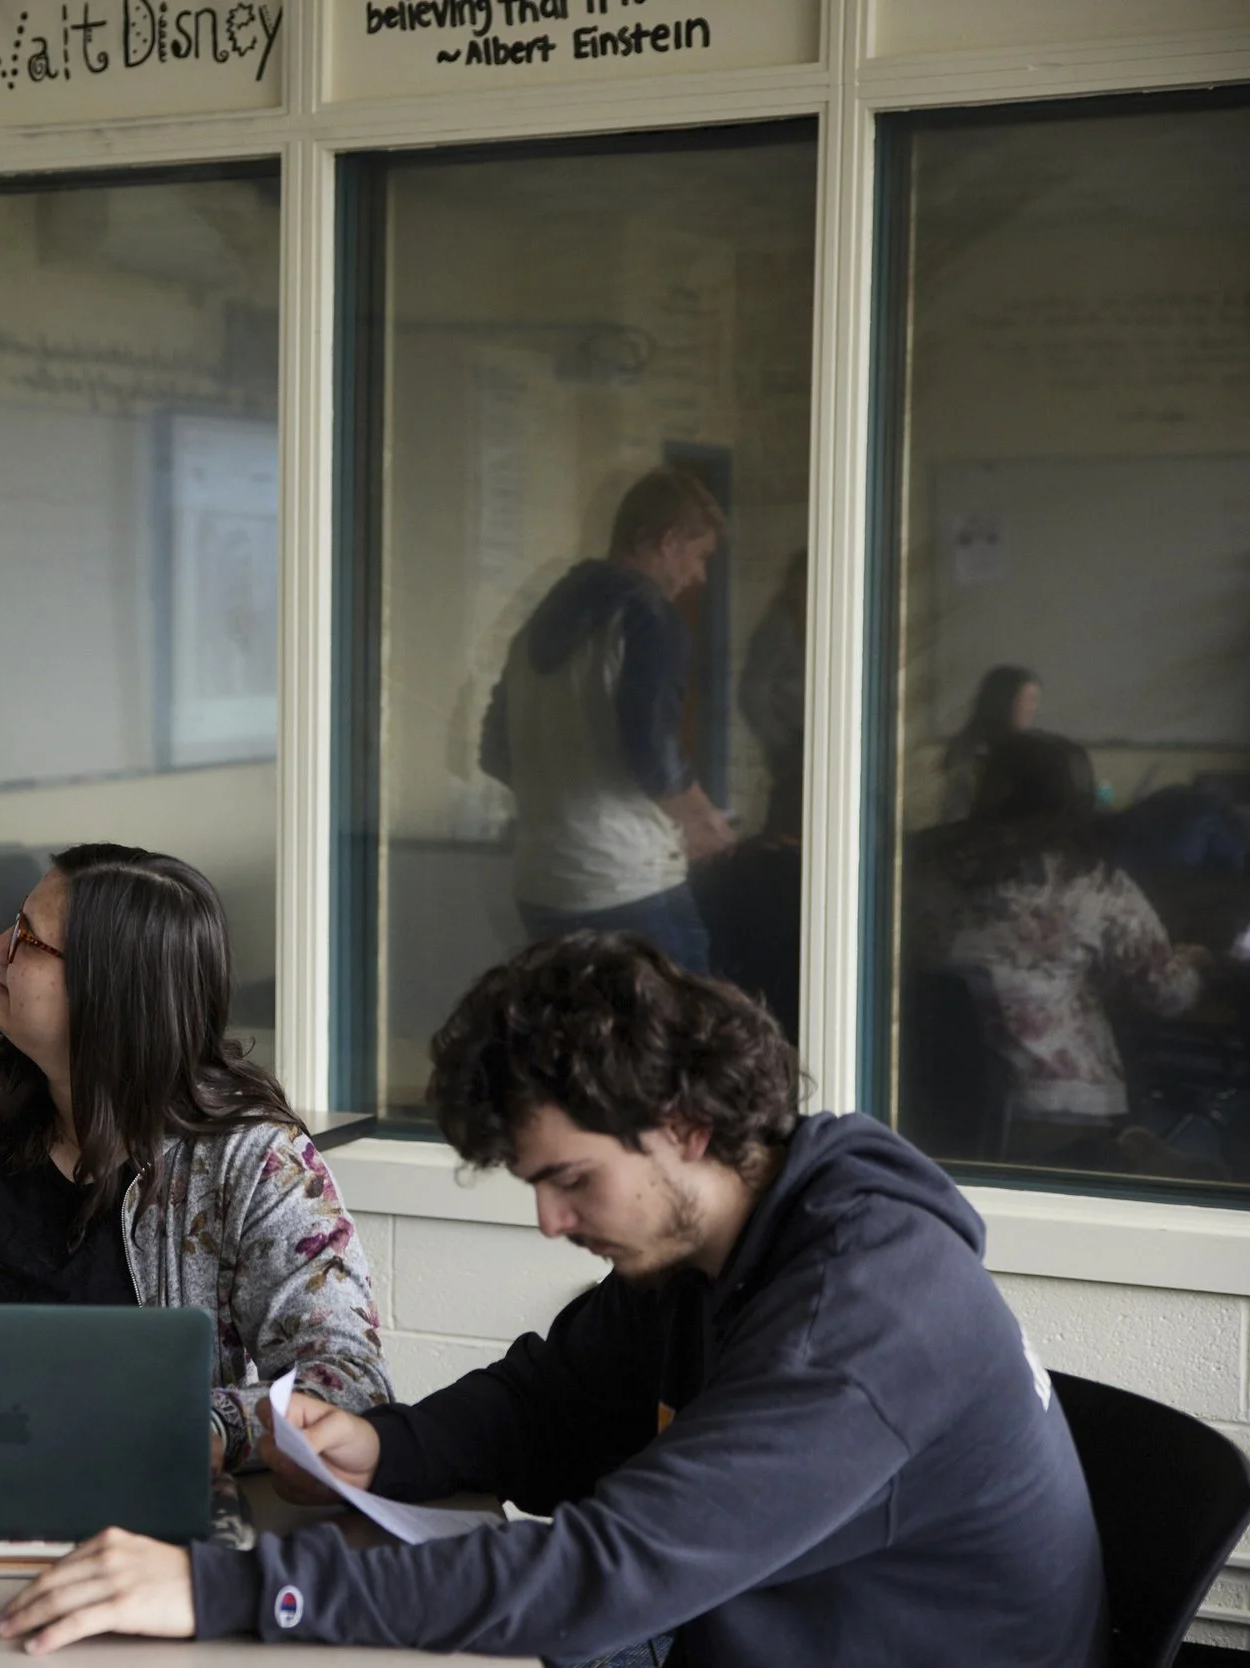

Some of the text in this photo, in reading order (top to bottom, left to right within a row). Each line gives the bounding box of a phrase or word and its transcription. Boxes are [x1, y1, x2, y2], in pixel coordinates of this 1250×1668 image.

[123, 0, 283, 81] Disney
[366, 0, 493, 37] believing
[573, 16, 711, 60] Einstein
